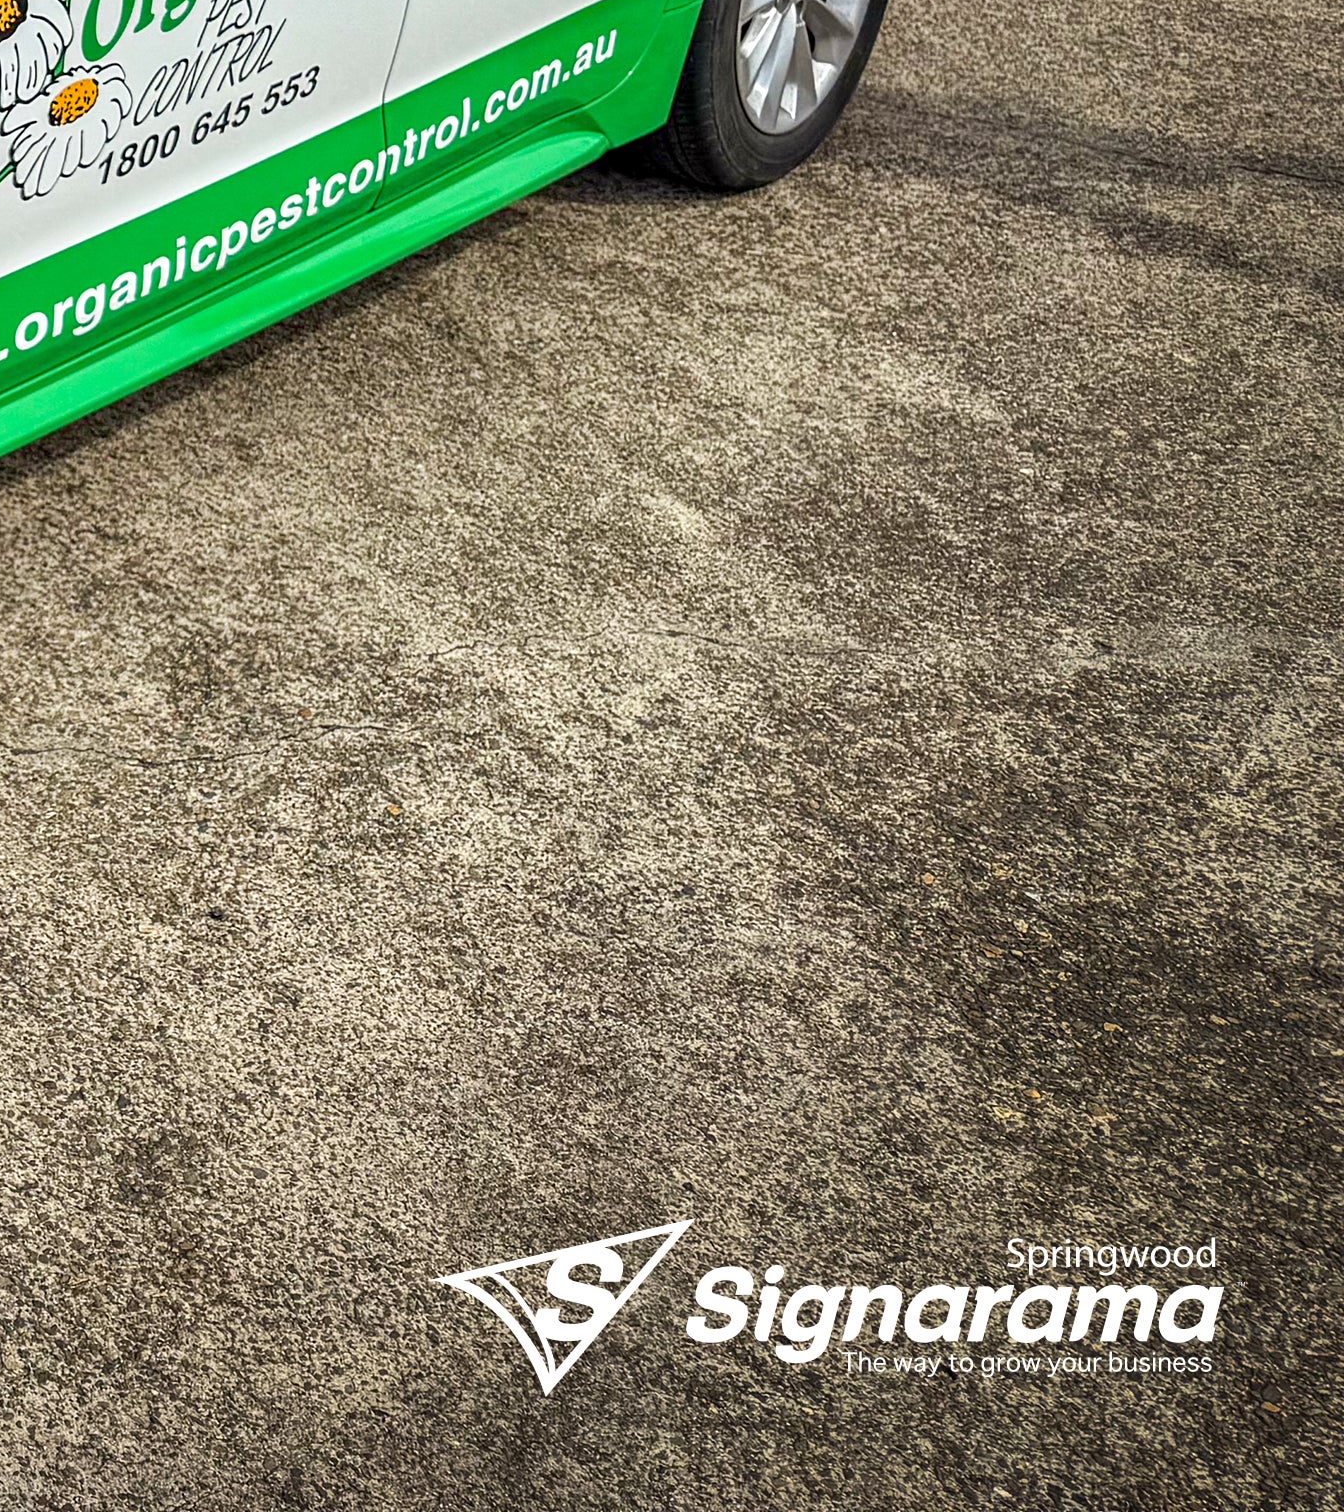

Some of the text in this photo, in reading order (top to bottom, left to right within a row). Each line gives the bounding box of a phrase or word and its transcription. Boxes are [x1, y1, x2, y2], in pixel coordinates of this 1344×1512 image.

[98, 65, 320, 185] 1800 645 553
[133, 18, 287, 127] CONTROL
